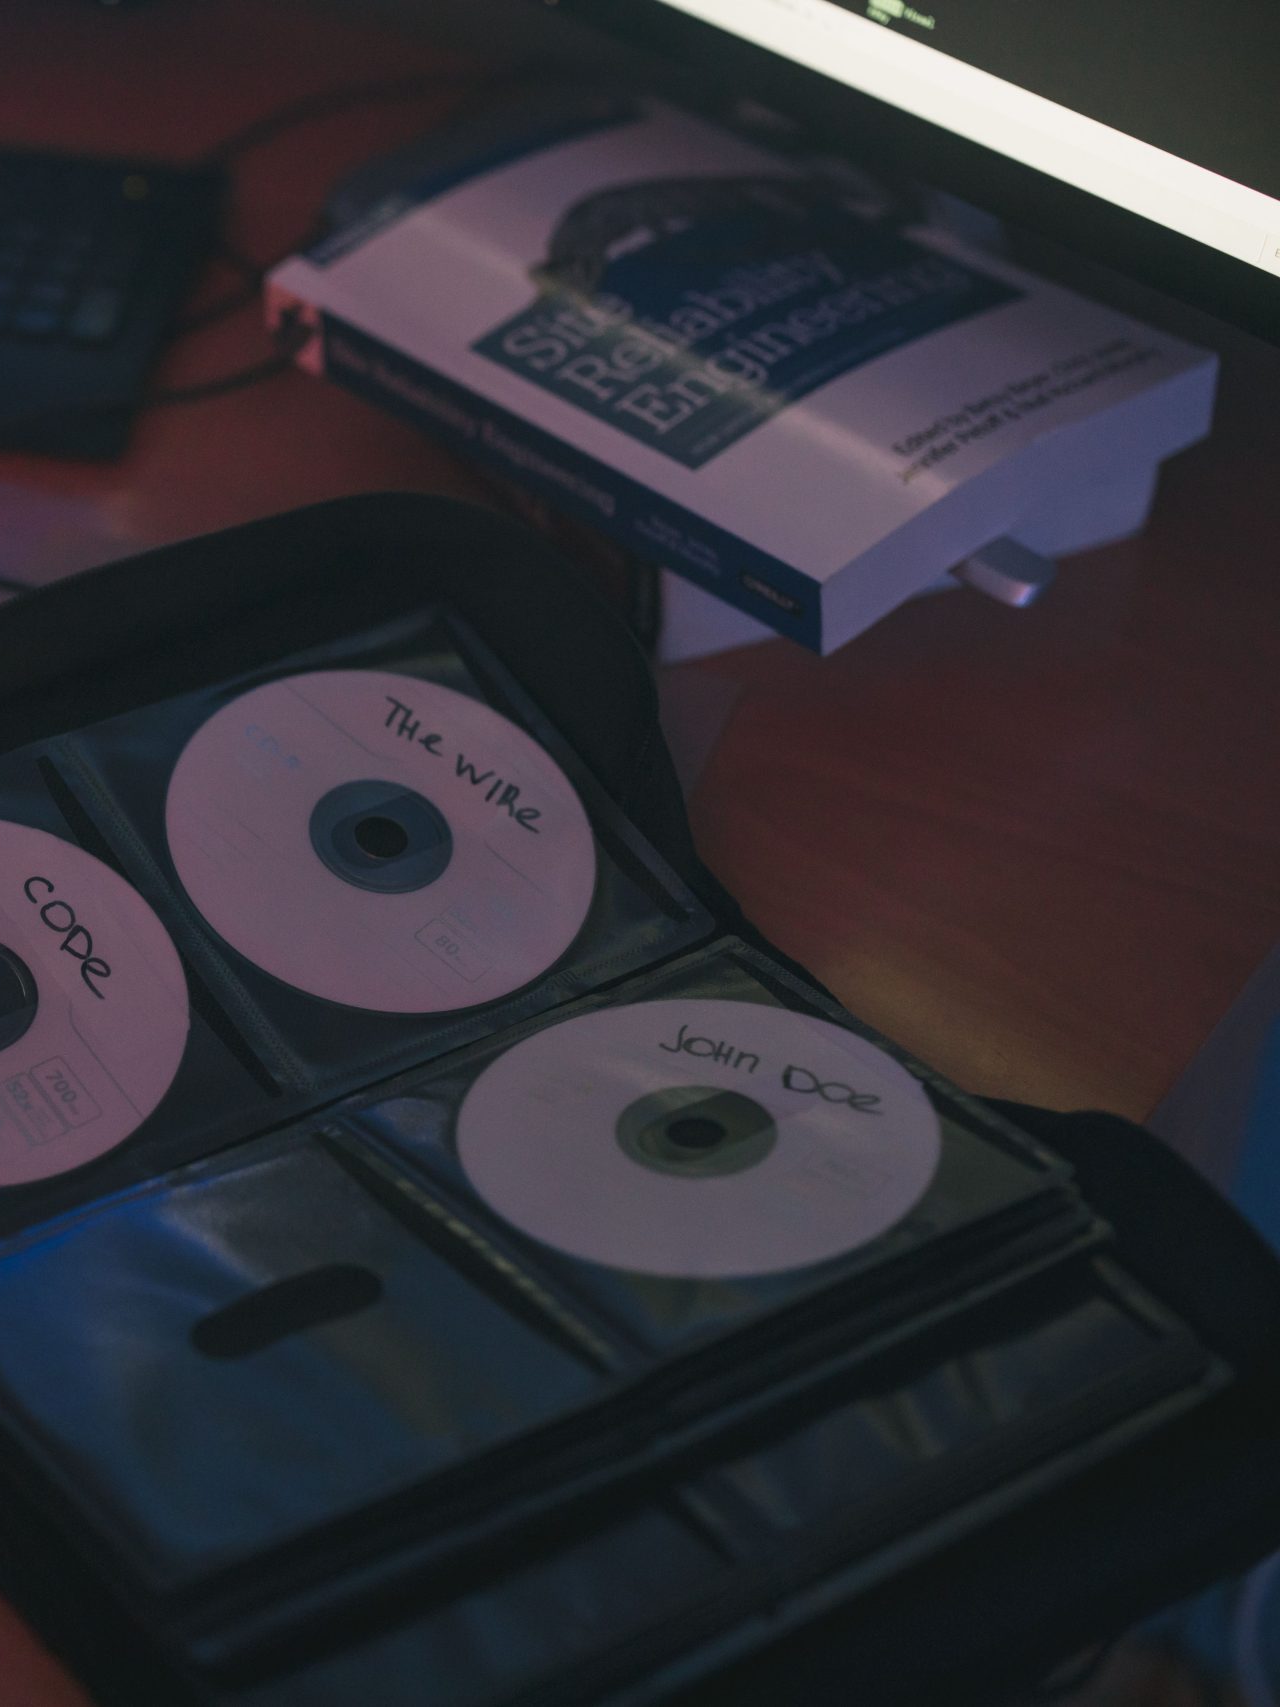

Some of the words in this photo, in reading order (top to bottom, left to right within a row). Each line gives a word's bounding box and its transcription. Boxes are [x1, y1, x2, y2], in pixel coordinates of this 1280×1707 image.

[502, 291, 634, 374] Site
[555, 248, 845, 404] Reliability
[614, 256, 974, 436] Engineering
[435, 935, 460, 955] 80
[45, 1070, 77, 1103] 700
